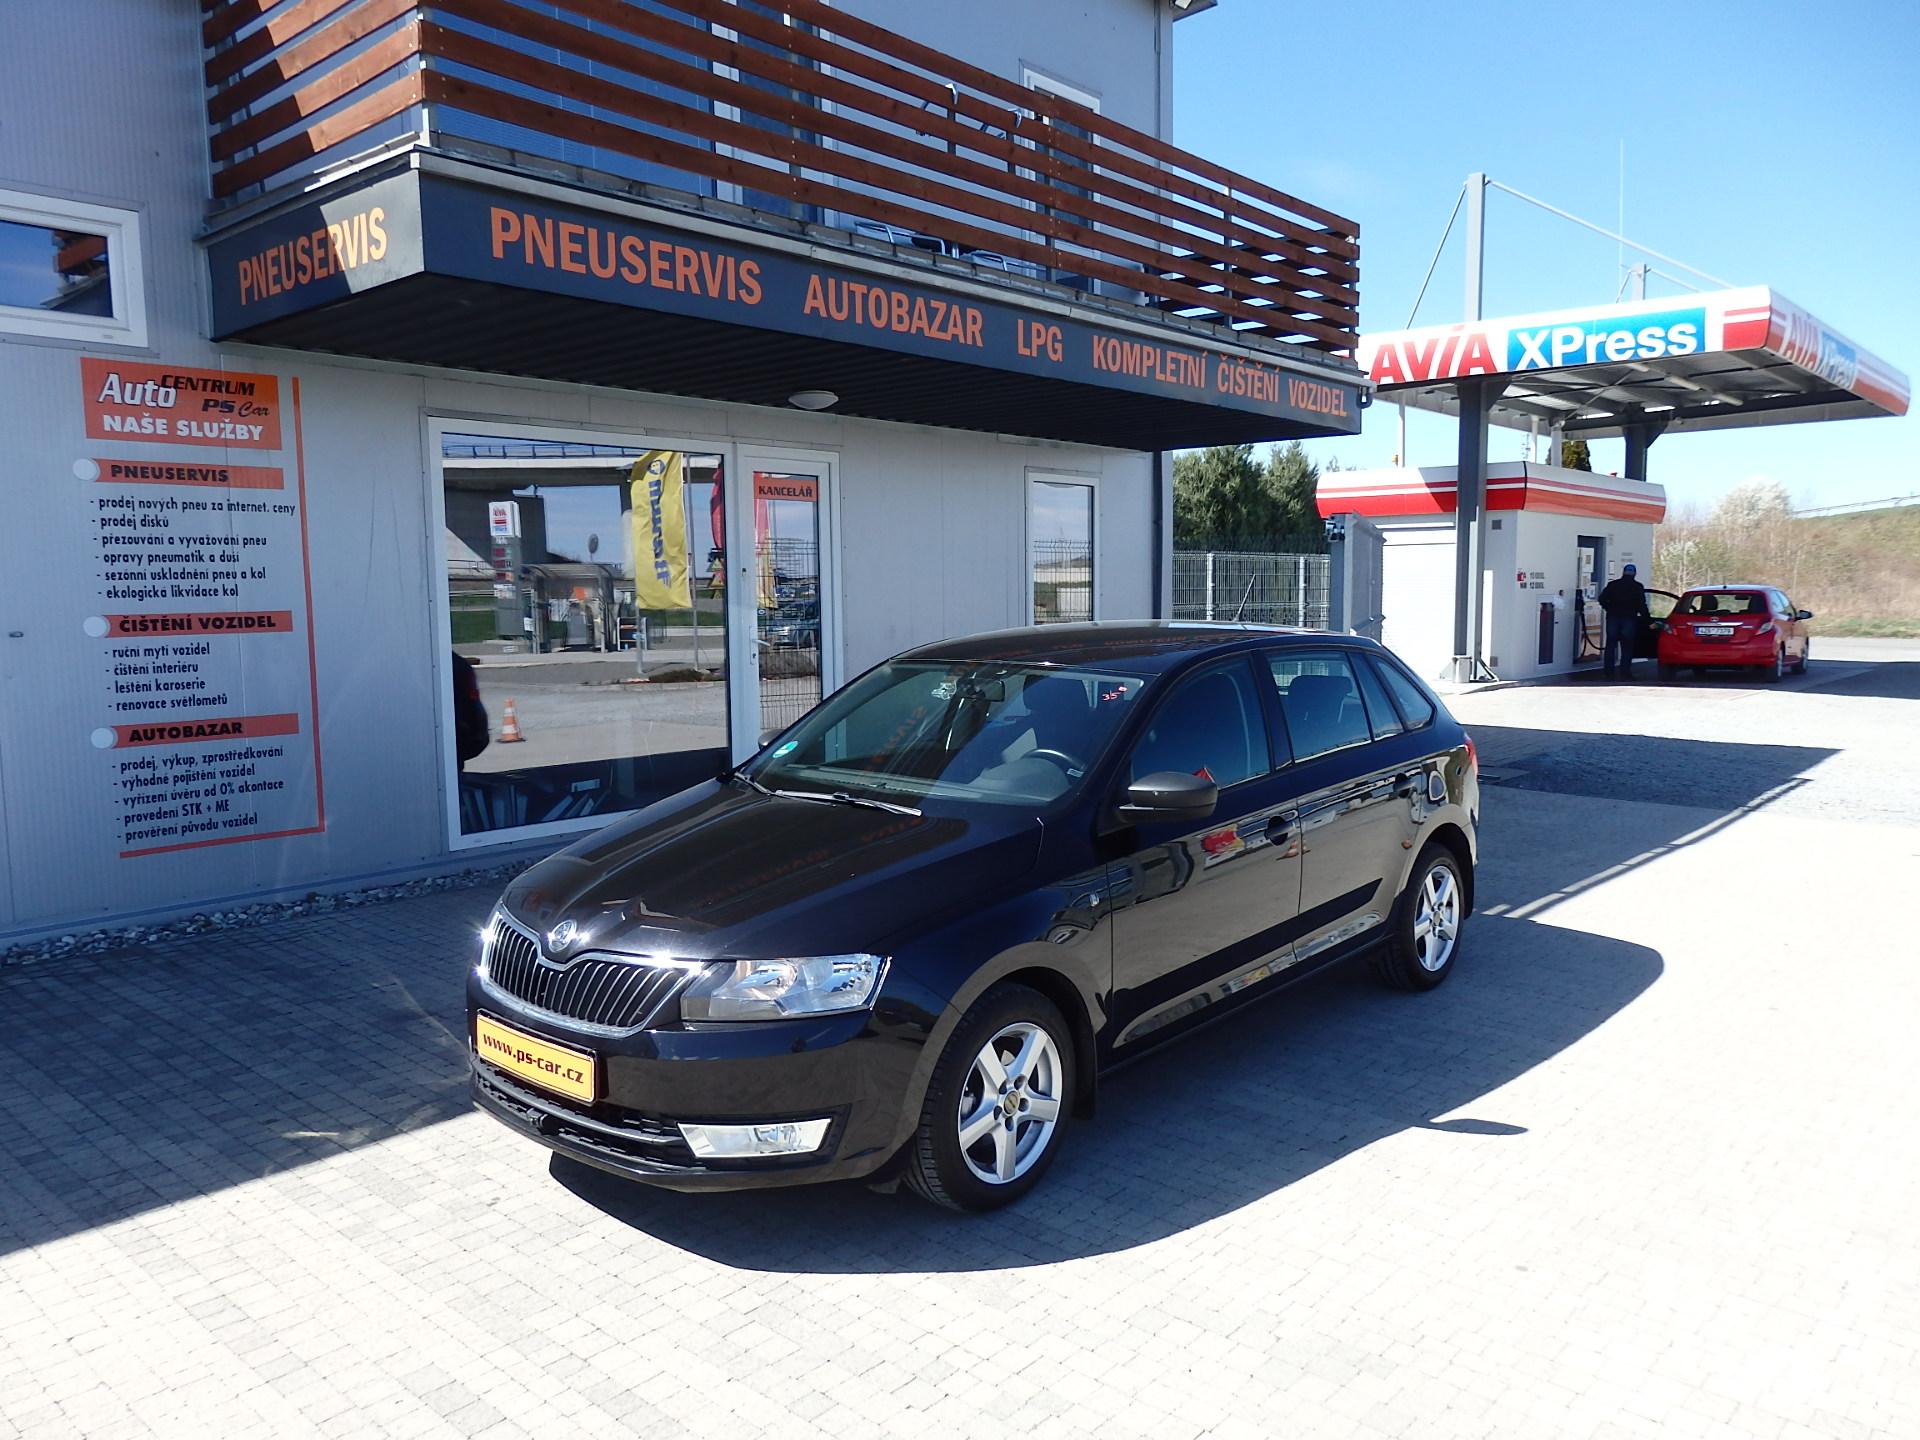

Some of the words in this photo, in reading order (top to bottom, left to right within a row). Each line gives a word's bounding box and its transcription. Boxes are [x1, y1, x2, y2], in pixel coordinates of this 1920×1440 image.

[238, 207, 388, 305] PNEUSERVIS
[490, 206, 762, 305] PNEUSERVIS
[803, 274, 983, 347] AUTOBAZAR
[1018, 319, 1063, 363] LPG
[1092, 335, 1208, 390] KOMPLETNÍ
[1217, 354, 1280, 404] ČIŠTĚNÍ
[1288, 378, 1348, 417] VOZIDEL
[1515, 323, 1697, 371] XPress
[97, 372, 177, 408] Auto
[161, 374, 255, 396] CENTRUM
[202, 398, 236, 413] PS
[238, 400, 271, 417] Car
[103, 412, 169, 435] NAŠE
[176, 418, 264, 441] SLUŽBY
[111, 464, 229, 482] PNEUSERVIS
[758, 485, 813, 498] KANCELÁŘ
[98, 495, 135, 512] prodej
[138, 496, 178, 513] nových
[182, 501, 208, 513] pneu
[211, 502, 223, 511] za
[273, 504, 296, 516] ceny
[100, 513, 137, 530] prodej
[102, 533, 164, 549] přezouvání
[168, 536, 175, 545] a
[178, 533, 239, 549] vyvažování
[242, 537, 267, 549] pneu
[103, 554, 143, 566] opravy
[147, 549, 205, 566] pneumatik
[209, 554, 216, 563] a
[219, 549, 240, 563] duší
[150, 567, 209, 580] uskladnění
[212, 570, 238, 583] pneu
[240, 571, 247, 580] a
[250, 566, 266, 580] kol
[106, 585, 167, 602] ekologická
[170, 584, 219, 598] likvidace
[222, 583, 239, 597] kol
[119, 614, 192, 632] ČIŠTĚNÍ
[199, 615, 276, 630] VOZIDEL
[112, 646, 140, 658] ruční
[172, 642, 210, 656] vozidel
[114, 662, 149, 676] čištění
[152, 661, 199, 674] interiéru
[115, 680, 152, 693] leštění
[155, 678, 206, 692] karoserie
[116, 699, 167, 711] renovace
[171, 693, 228, 708] světlometů
[129, 722, 243, 742] AUTOBAZAR
[162, 753, 198, 770] výkup,
[202, 746, 283, 766] zprostředkování
[122, 773, 169, 791] výhodné
[219, 763, 255, 778] vozidel
[171, 788, 200, 801] úvěru
[204, 784, 216, 797] od
[220, 782, 235, 795] 0%
[238, 780, 284, 794] akontace
[124, 807, 179, 828] provedení
[182, 802, 202, 817] STK
[215, 799, 230, 813] ME
[181, 818, 219, 836] původu
[222, 812, 258, 828] vozidel
[483, 1033, 585, 1084] www.ps-car.cz
